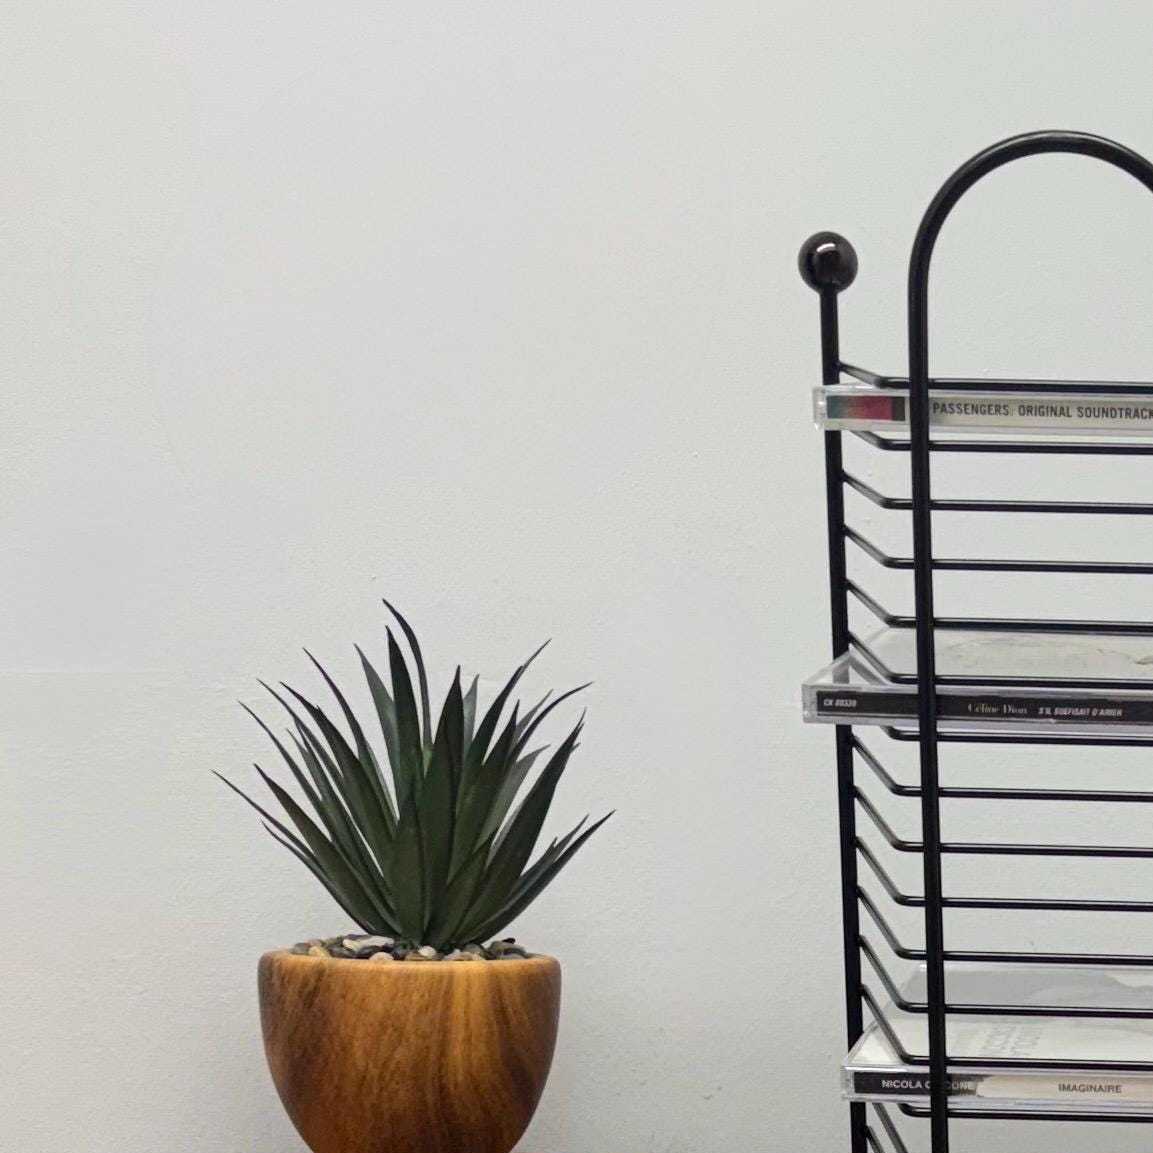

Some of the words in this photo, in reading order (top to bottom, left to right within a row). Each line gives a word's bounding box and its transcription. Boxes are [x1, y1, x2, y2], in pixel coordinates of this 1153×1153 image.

[1018, 404, 1073, 418] ORIGINAL
[881, 1079, 923, 1089] NICOLA
[1058, 1083, 1122, 1094] IMAGINAIRE
